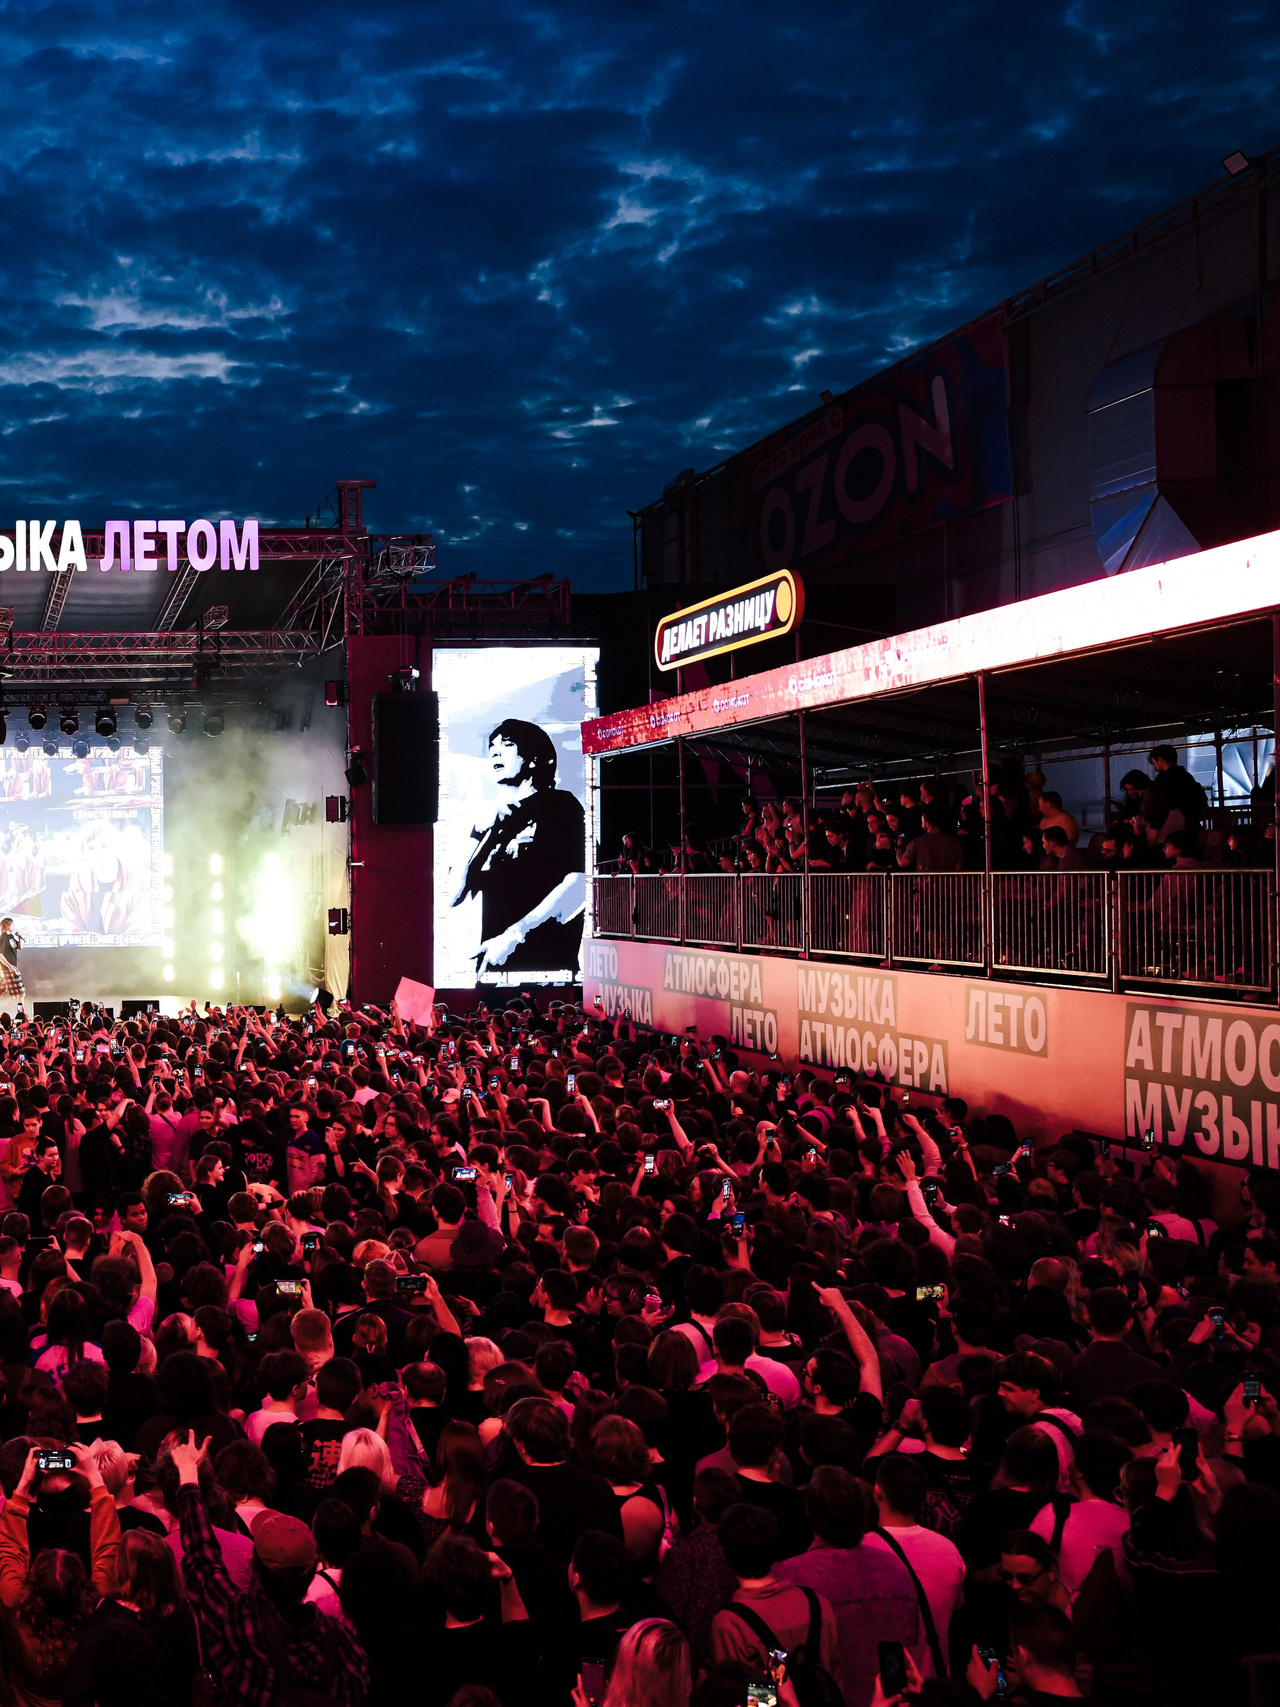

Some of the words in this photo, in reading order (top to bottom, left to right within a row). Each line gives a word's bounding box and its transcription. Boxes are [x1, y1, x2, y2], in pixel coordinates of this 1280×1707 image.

[760, 375, 954, 570] OZON
[99, 519, 260, 572] ЛЕТОМ
[661, 614, 708, 663] ДЕЛАЕТ
[709, 589, 775, 642] РАЗНИЦУ
[588, 945, 619, 981] ЛЕТО
[663, 959, 763, 1004] АТМОСФЕРА
[598, 983, 653, 1027] МУЗЫКА
[798, 968, 896, 1027] МУЗЫКА
[965, 988, 1047, 1053] ЛЕТО
[730, 1006, 777, 1053] ЛЕТО
[799, 1020, 949, 1096] АТМОСФЕРА
